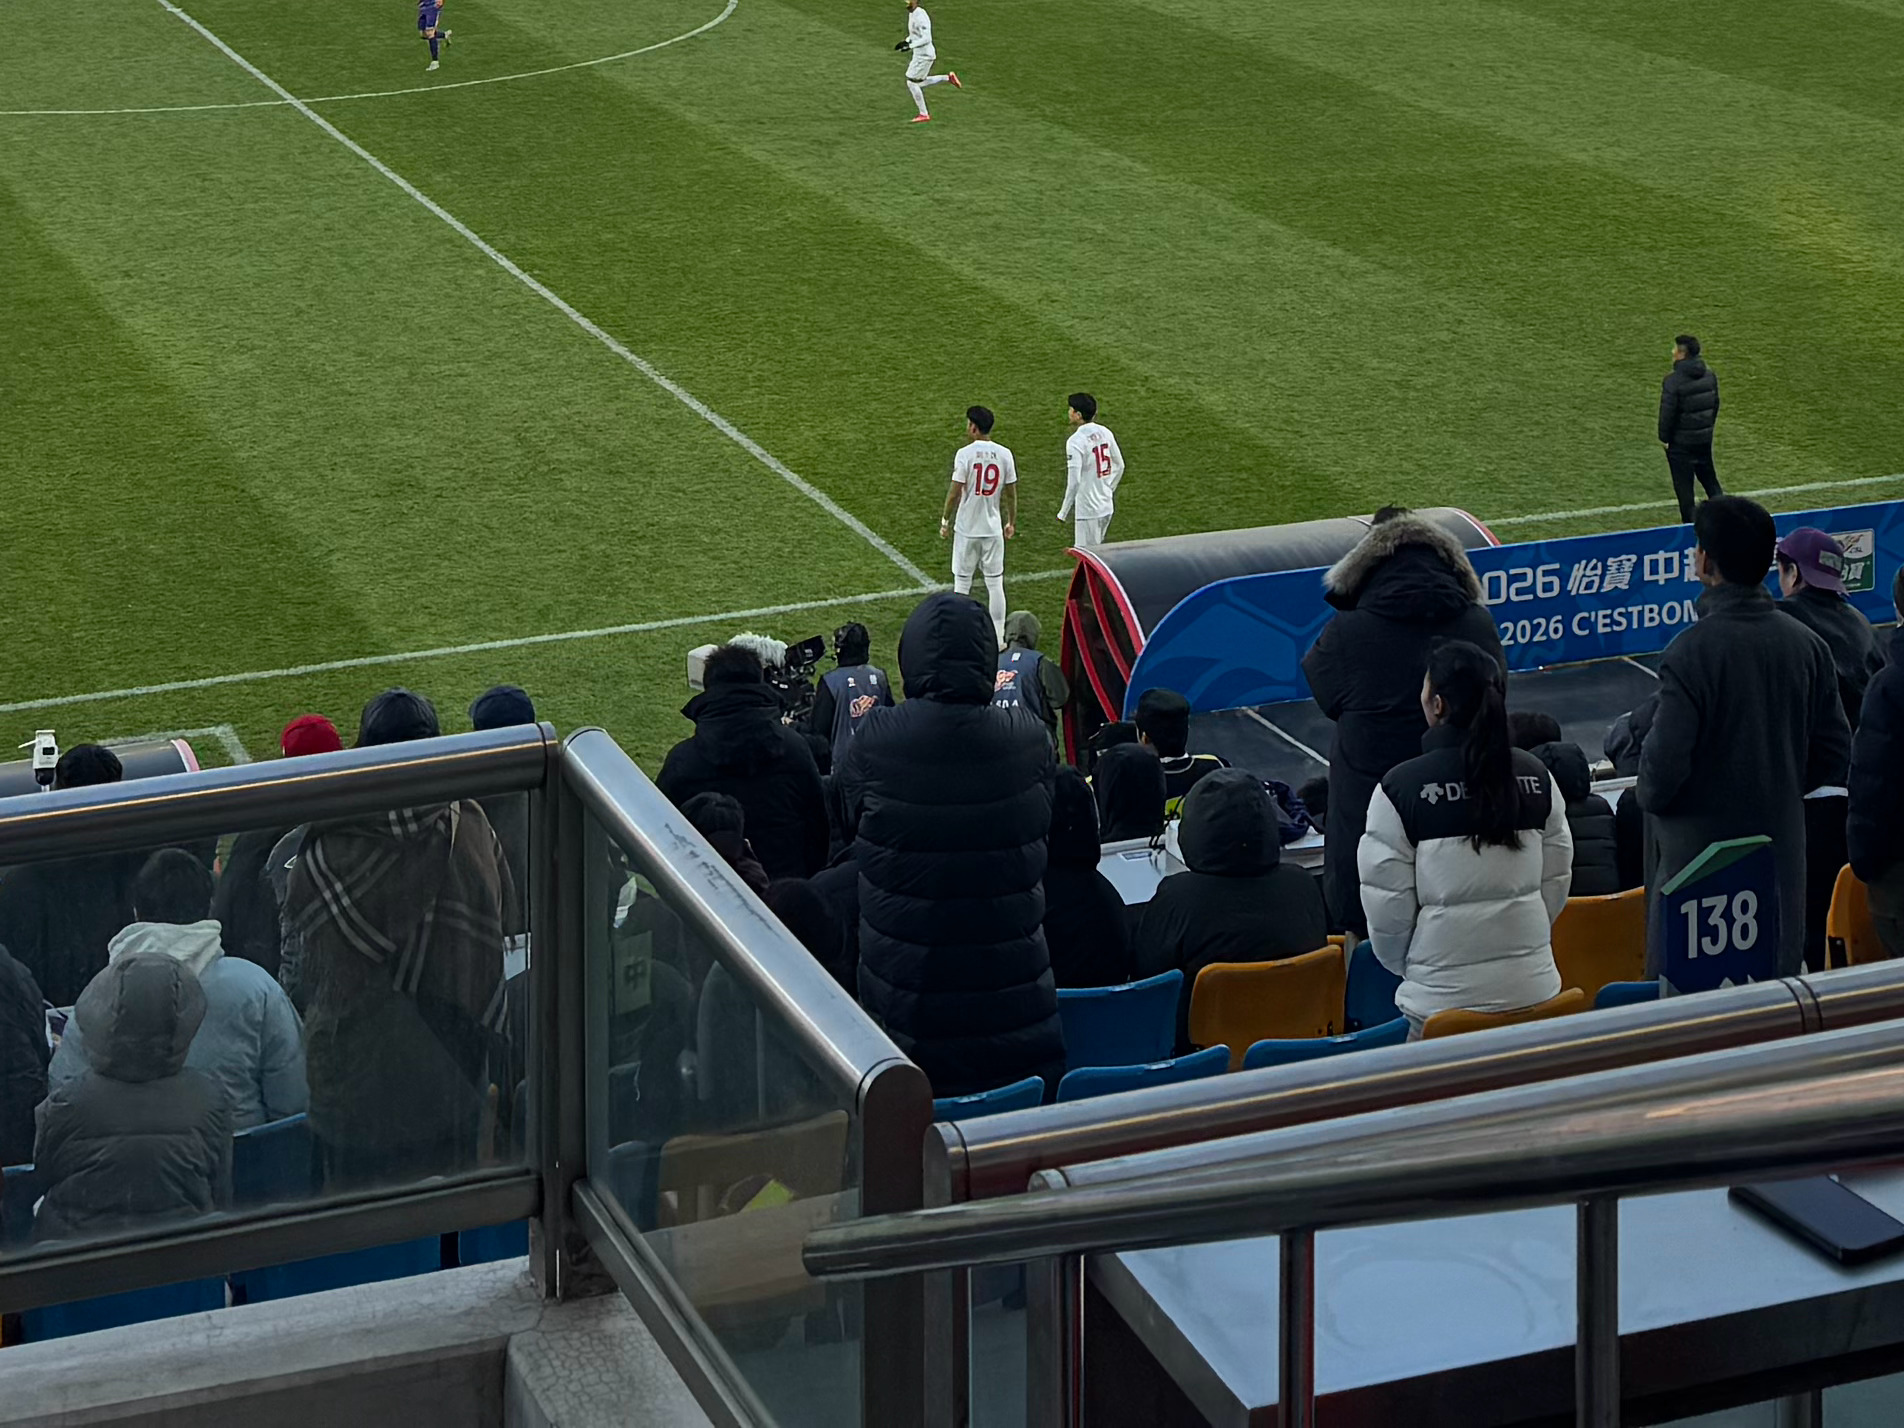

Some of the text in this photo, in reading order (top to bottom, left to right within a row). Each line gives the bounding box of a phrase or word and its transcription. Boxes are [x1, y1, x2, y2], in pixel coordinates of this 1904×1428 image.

[973, 462, 1000, 496] 19
[1092, 443, 1112, 479] 15
[1482, 562, 1561, 605] 026
[1500, 618, 1564, 647] 2026
[1679, 889, 1758, 959] 138
